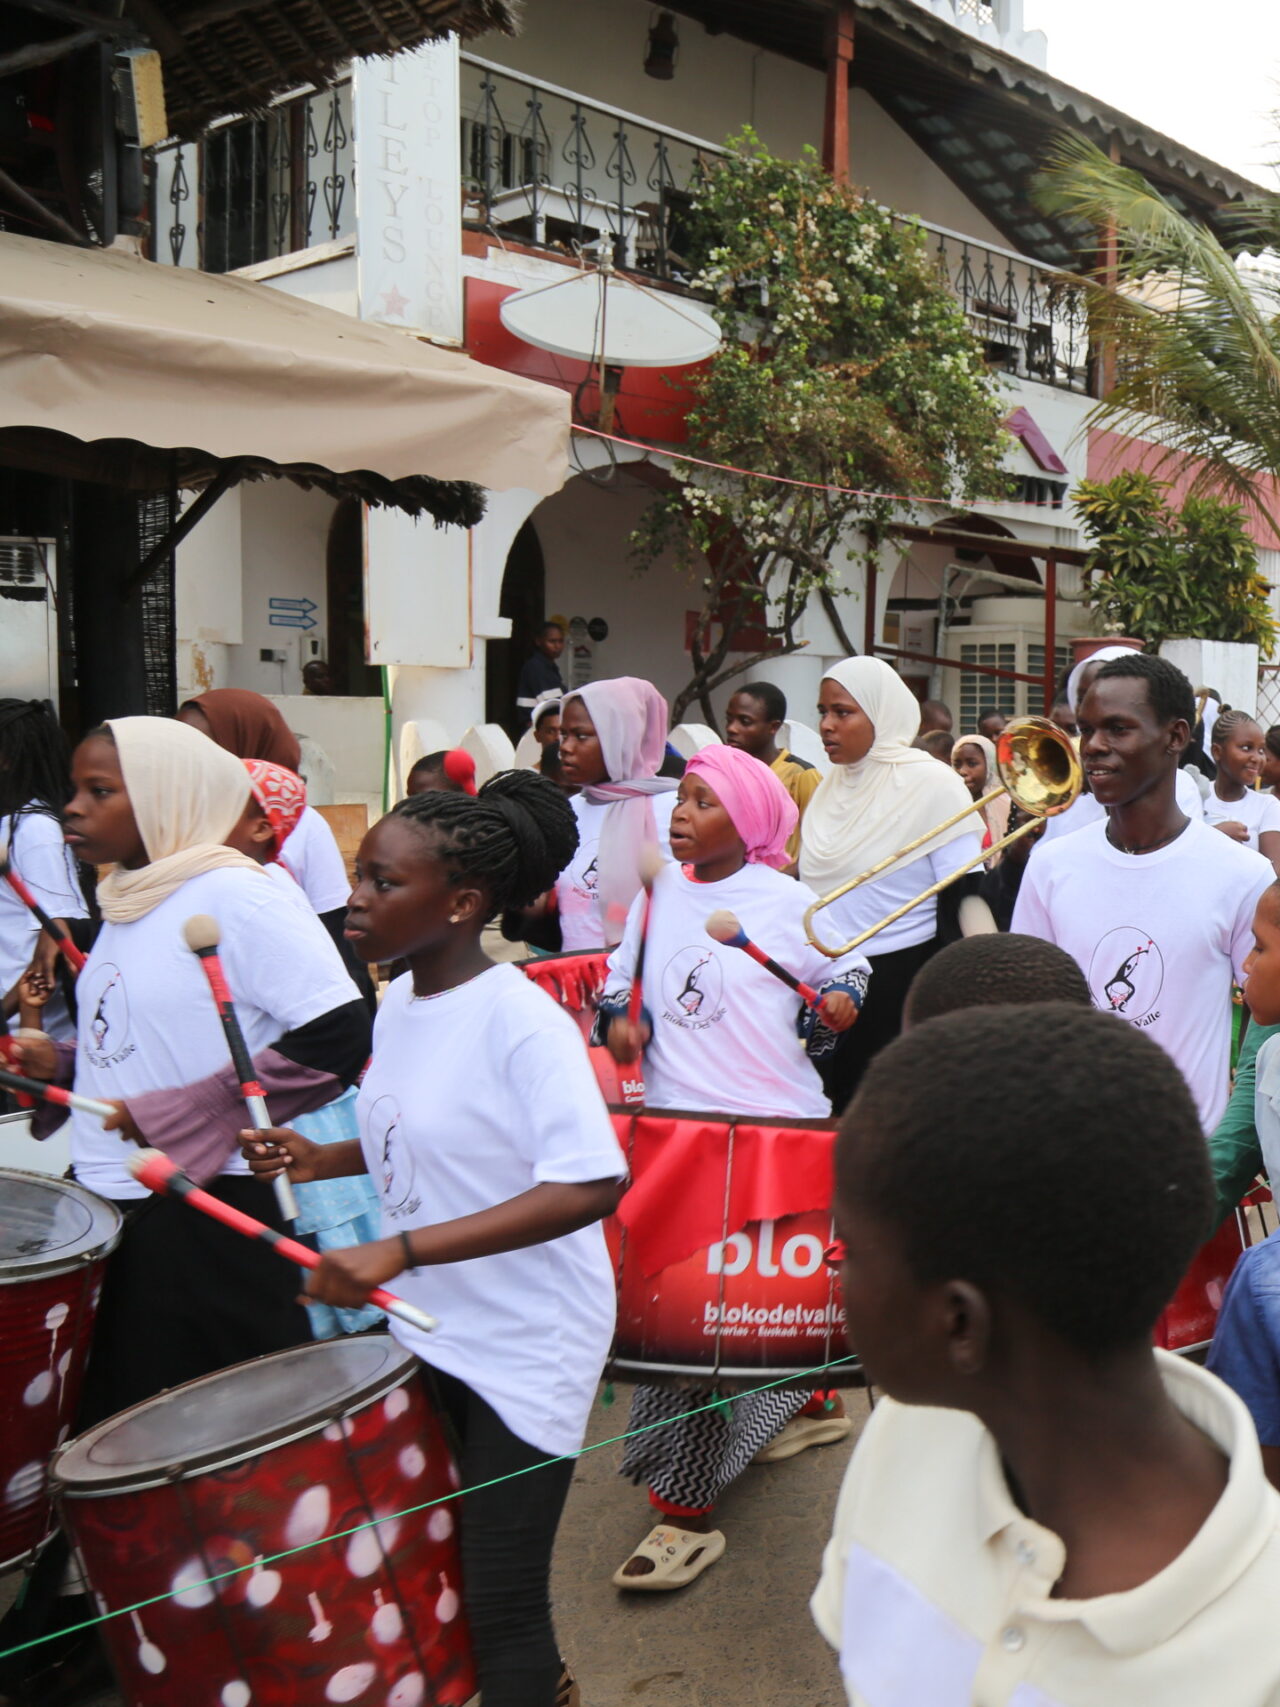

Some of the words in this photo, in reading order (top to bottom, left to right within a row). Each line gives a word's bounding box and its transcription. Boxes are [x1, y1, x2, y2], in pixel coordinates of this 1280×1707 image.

[1133, 1011, 1161, 1028] Valle
[706, 1219, 840, 1278] blo
[703, 1300, 848, 1325] blokodelvalle
